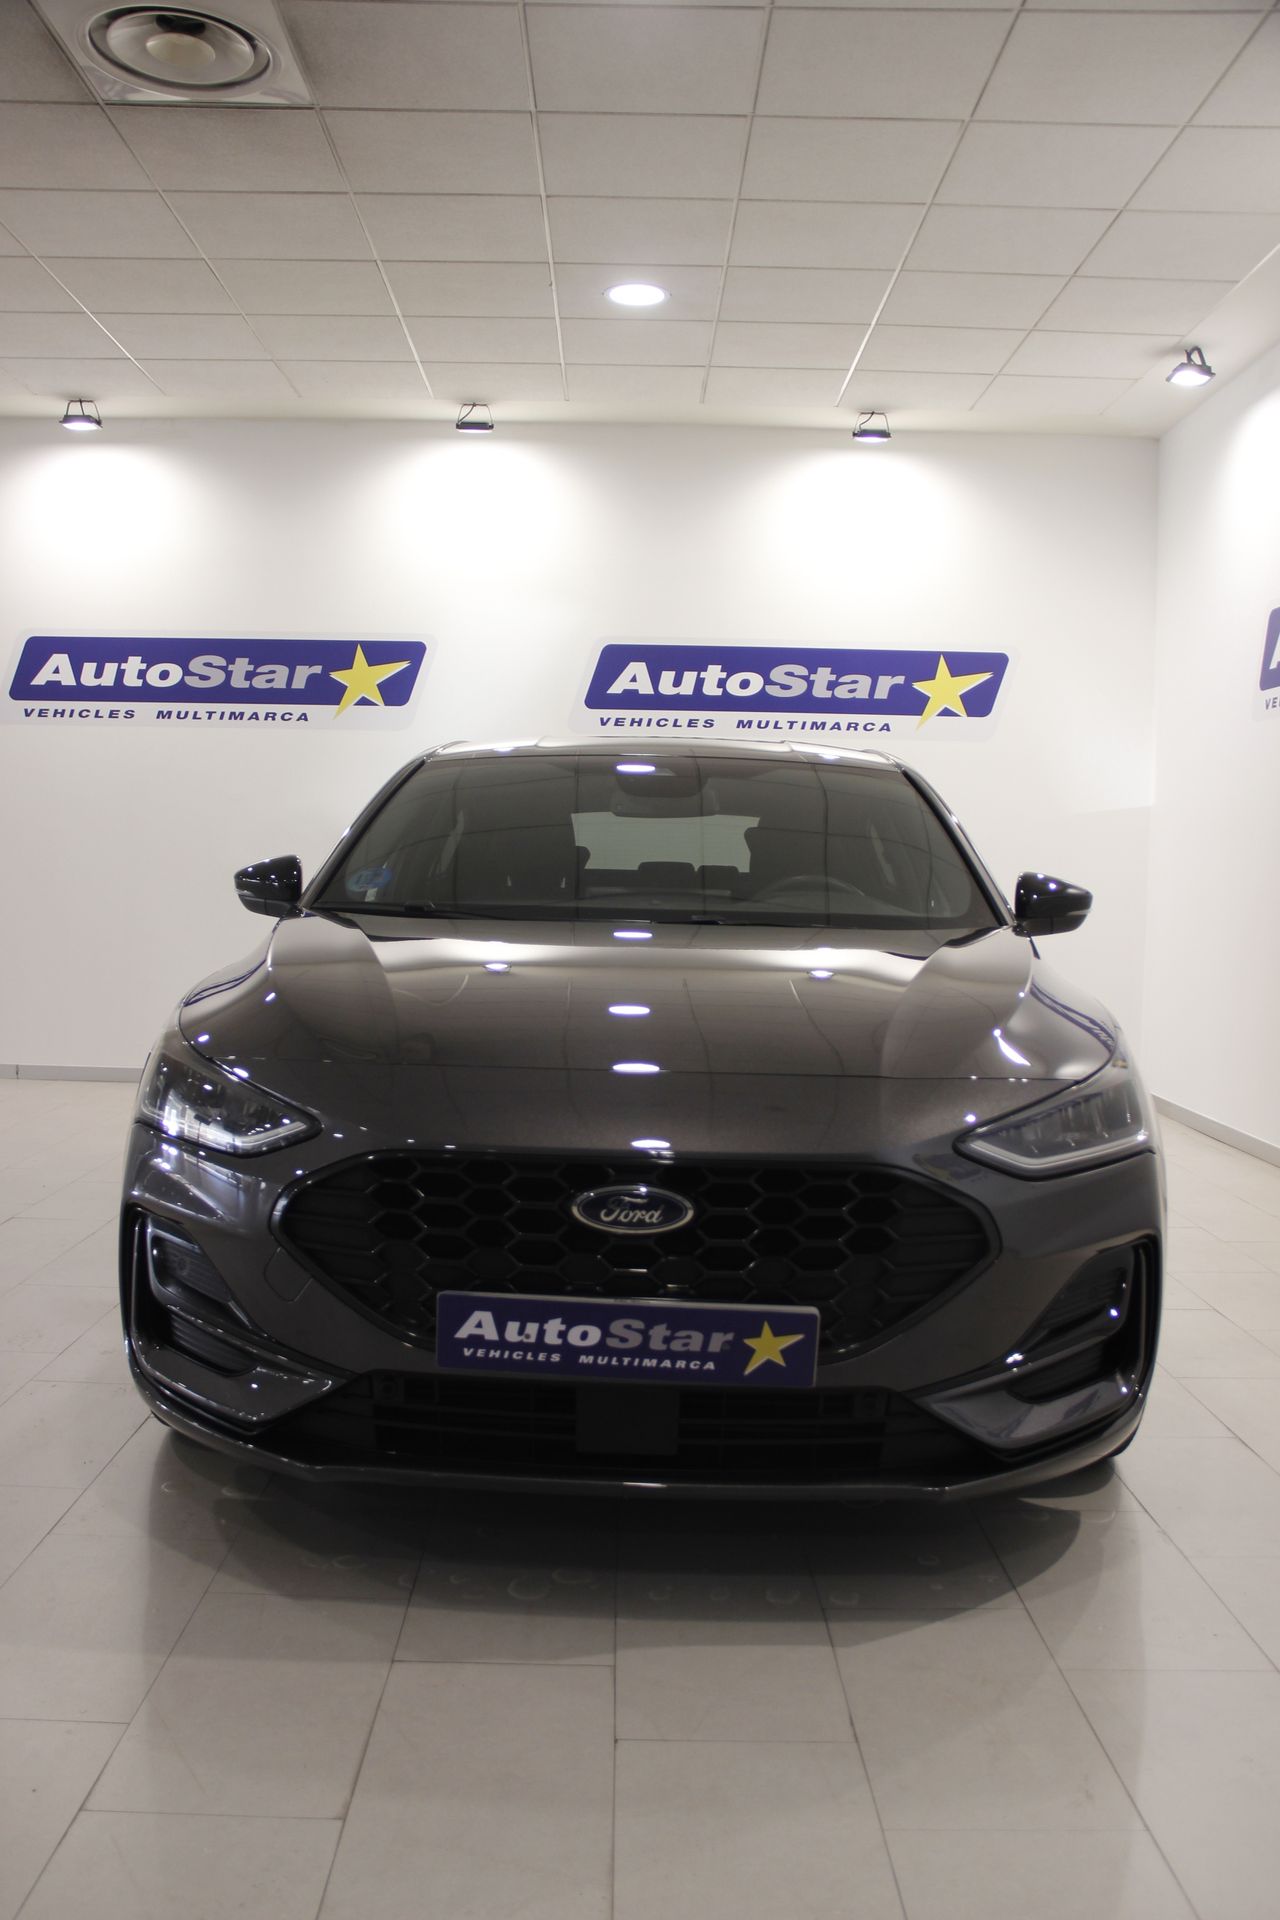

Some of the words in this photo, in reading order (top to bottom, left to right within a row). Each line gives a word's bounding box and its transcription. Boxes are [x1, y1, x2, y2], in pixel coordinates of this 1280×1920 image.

[30, 653, 323, 689] AutoStar
[606, 661, 905, 699] AutoStar
[23, 708, 136, 719] VEHICLES
[156, 709, 309, 722] MULTIMARCA
[599, 717, 715, 728] VEHICLES
[736, 719, 892, 732] MULTIMARCA
[599, 1195, 665, 1223] Ford
[454, 1310, 736, 1353] AutoStar
[463, 1347, 561, 1362] VEHICLES
[578, 1354, 716, 1370] MULTIMARCA
